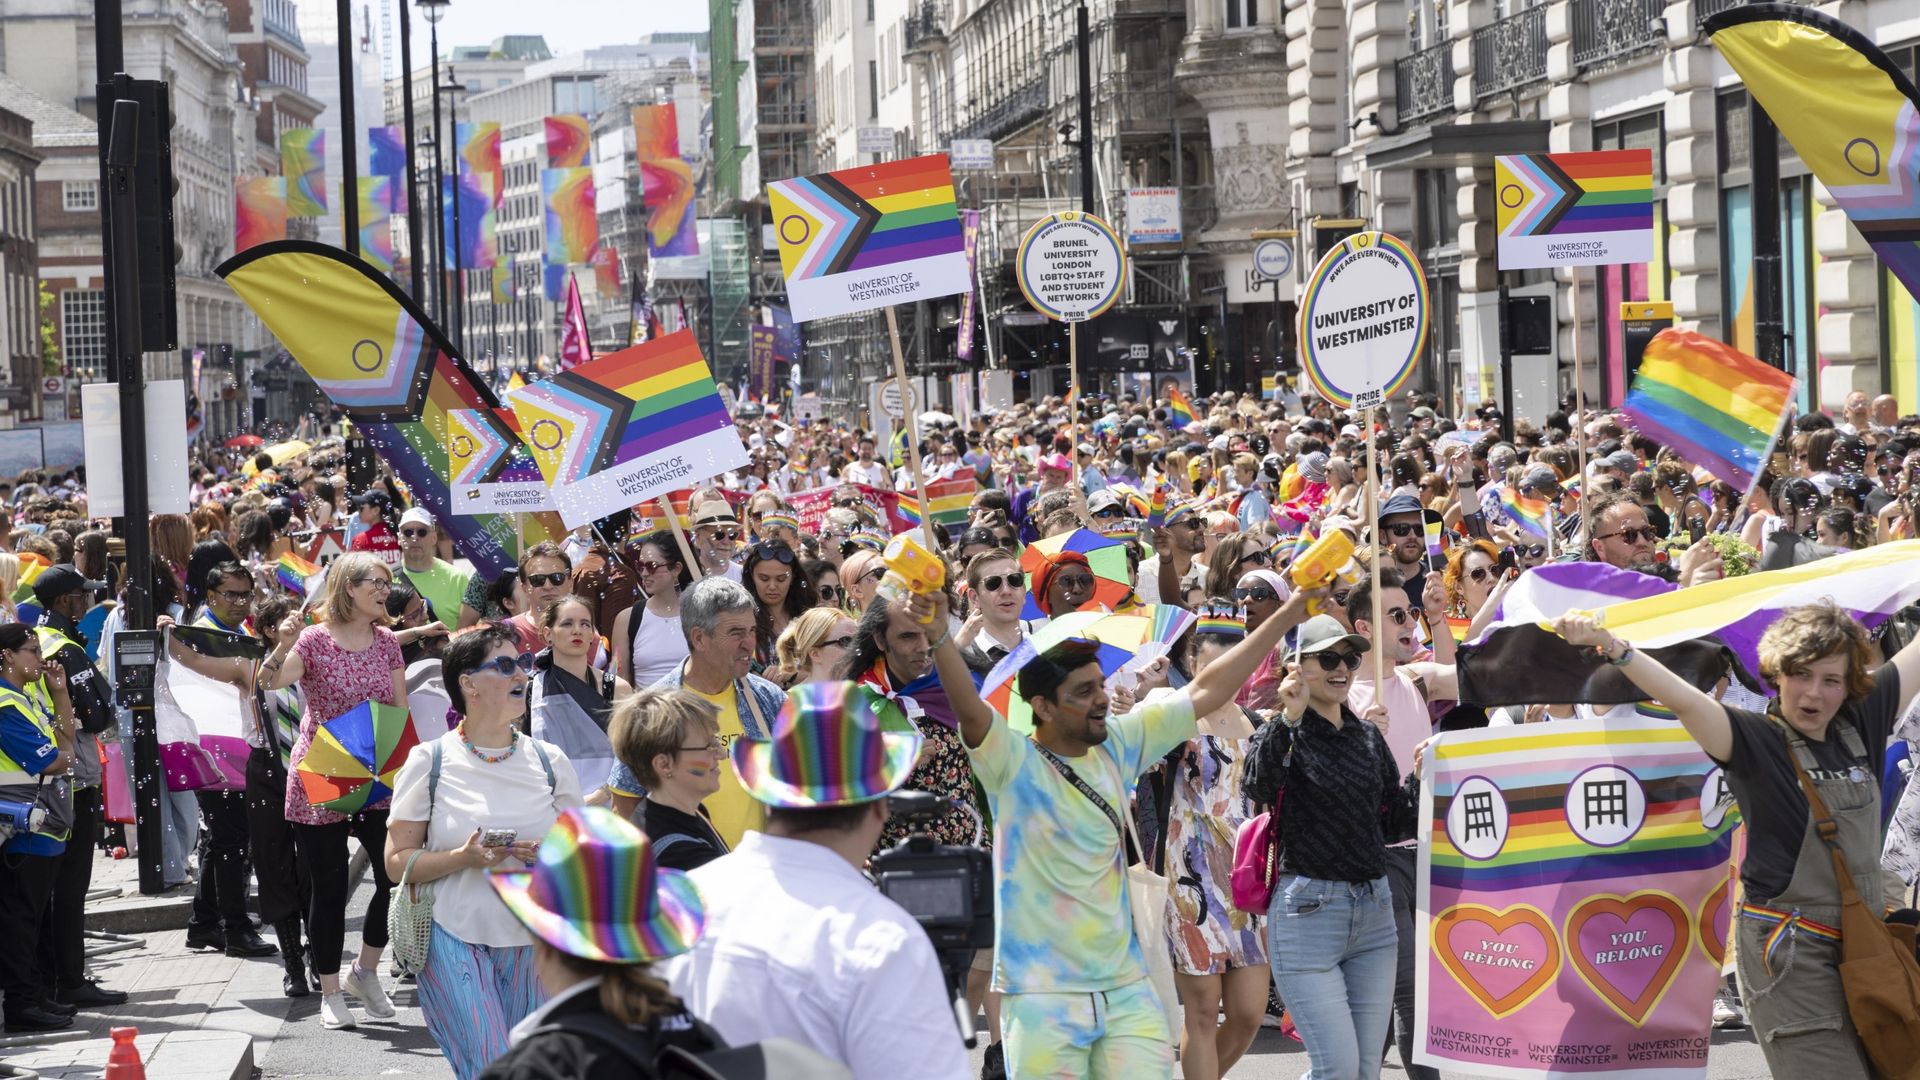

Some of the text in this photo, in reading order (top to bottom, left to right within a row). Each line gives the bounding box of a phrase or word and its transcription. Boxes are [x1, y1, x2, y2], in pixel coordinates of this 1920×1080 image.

[1053, 240, 1088, 248] BRUNEL
[1548, 241, 1604, 251] UNIVERSITY OF
[1044, 250, 1099, 259] UNIVERSITY
[1548, 249, 1604, 260] WESTMINSTER
[1052, 261, 1091, 269] LONDON
[848, 272, 913, 293] UNIVERSITY OF
[1040, 271, 1104, 281] LGBTQ+ STAFF
[850, 282, 916, 302] WESTMINSTER
[1042, 282, 1104, 292] AND STUDENT
[1047, 293, 1100, 302] NETWORKS
[1315, 293, 1415, 329] UNIVERSITY OF
[1317, 315, 1415, 351] WESTMINSTER
[1356, 389, 1380, 403] PRIDE
[1362, 399, 1380, 408] LONDON
[616, 455, 683, 488] UNIVERSITY OF
[621, 465, 689, 496] WESTMINSTER
[494, 490, 532, 498] UNIVERSITY
[1075, 779, 1106, 808] FOREVER
[1610, 930, 1647, 946] YOU
[1480, 939, 1519, 954] YOU
[1462, 950, 1535, 970] BELONG
[1594, 944, 1664, 965] BELONG
[1430, 1026, 1513, 1047] UNIVERSITY OF
[1430, 1037, 1511, 1058] WESTMINSTER
[1528, 1043, 1612, 1055] UNIVERSITY OF
[1627, 1037, 1709, 1052] UNIVERSITY OF
[1528, 1053, 1611, 1065] WESTMINSTER
[1627, 1049, 1708, 1061] WESTMINSTER
